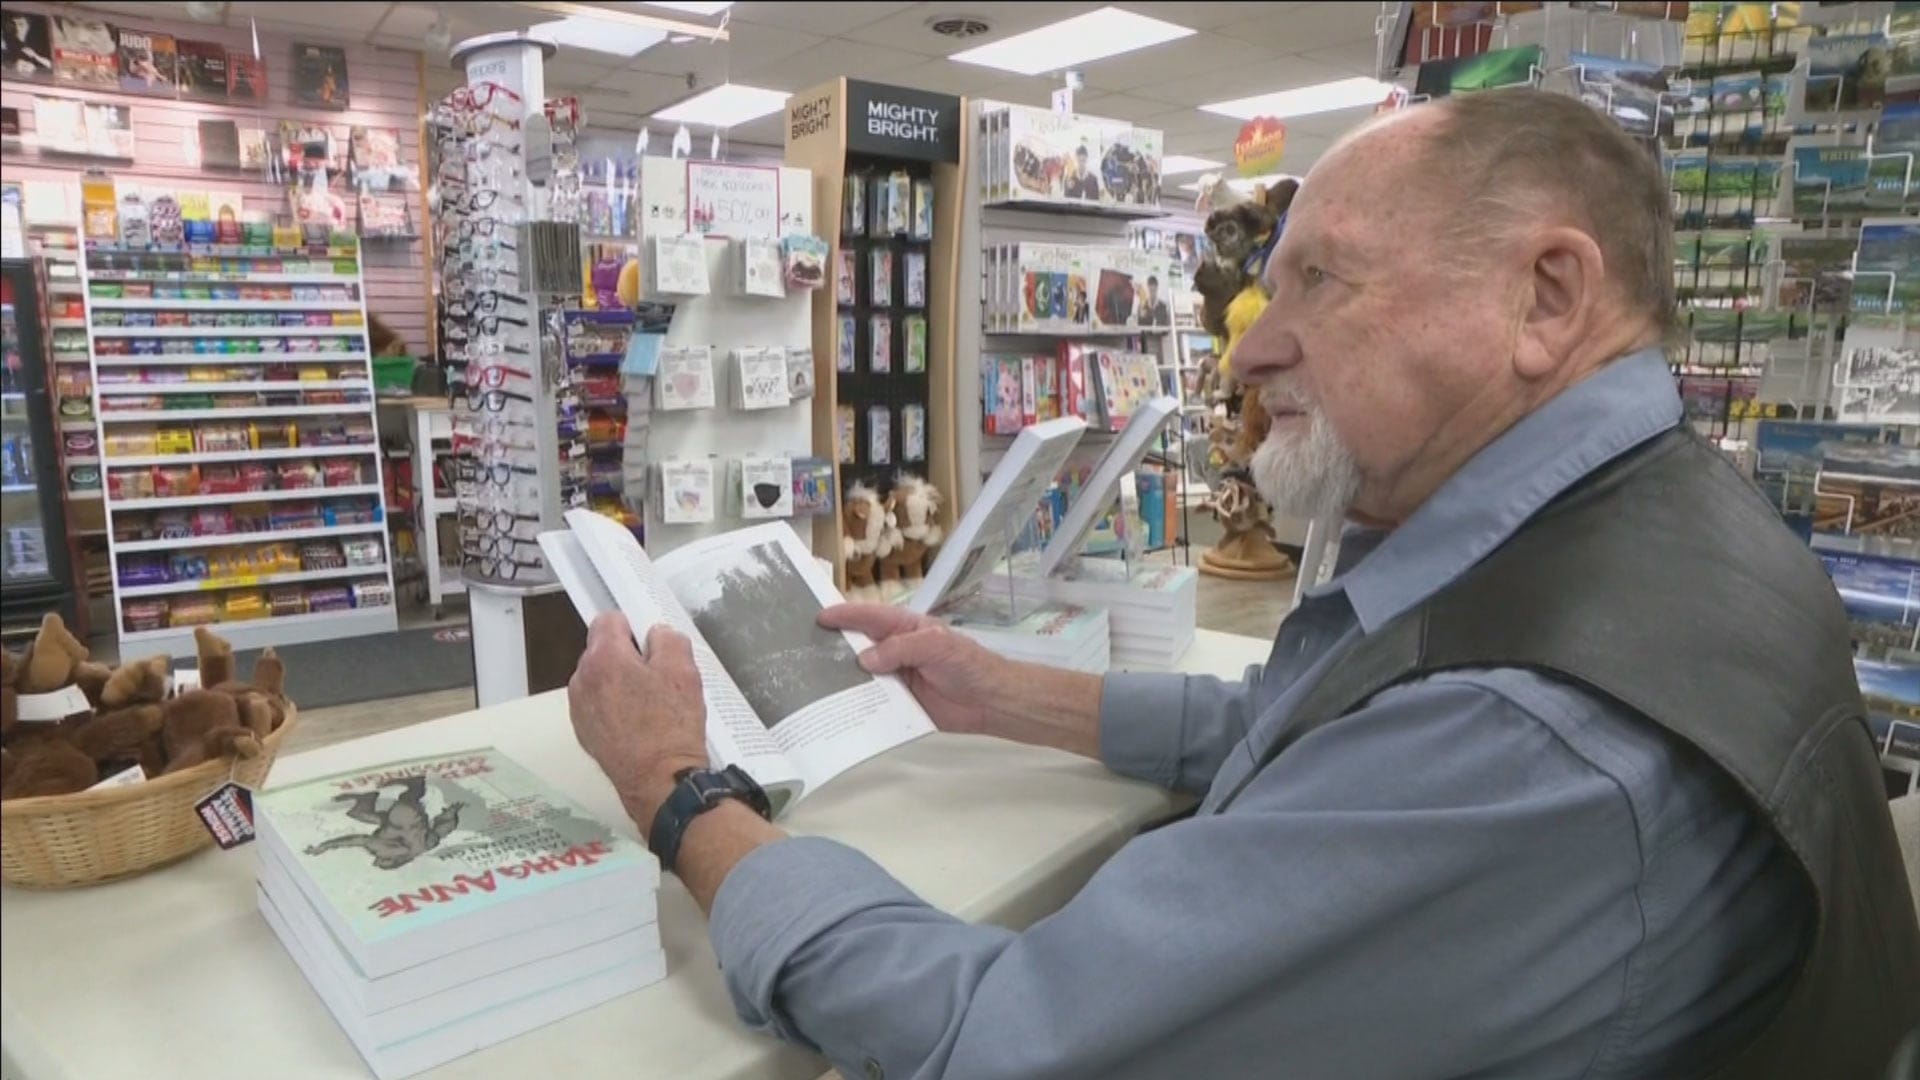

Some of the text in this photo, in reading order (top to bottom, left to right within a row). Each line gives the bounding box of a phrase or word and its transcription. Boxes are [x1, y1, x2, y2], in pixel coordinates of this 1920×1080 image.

[119, 31, 151, 49] JUDO
[791, 95, 831, 121] MIGHTY
[867, 100, 940, 125] MIGHTY
[791, 113, 831, 140] BRIGHT
